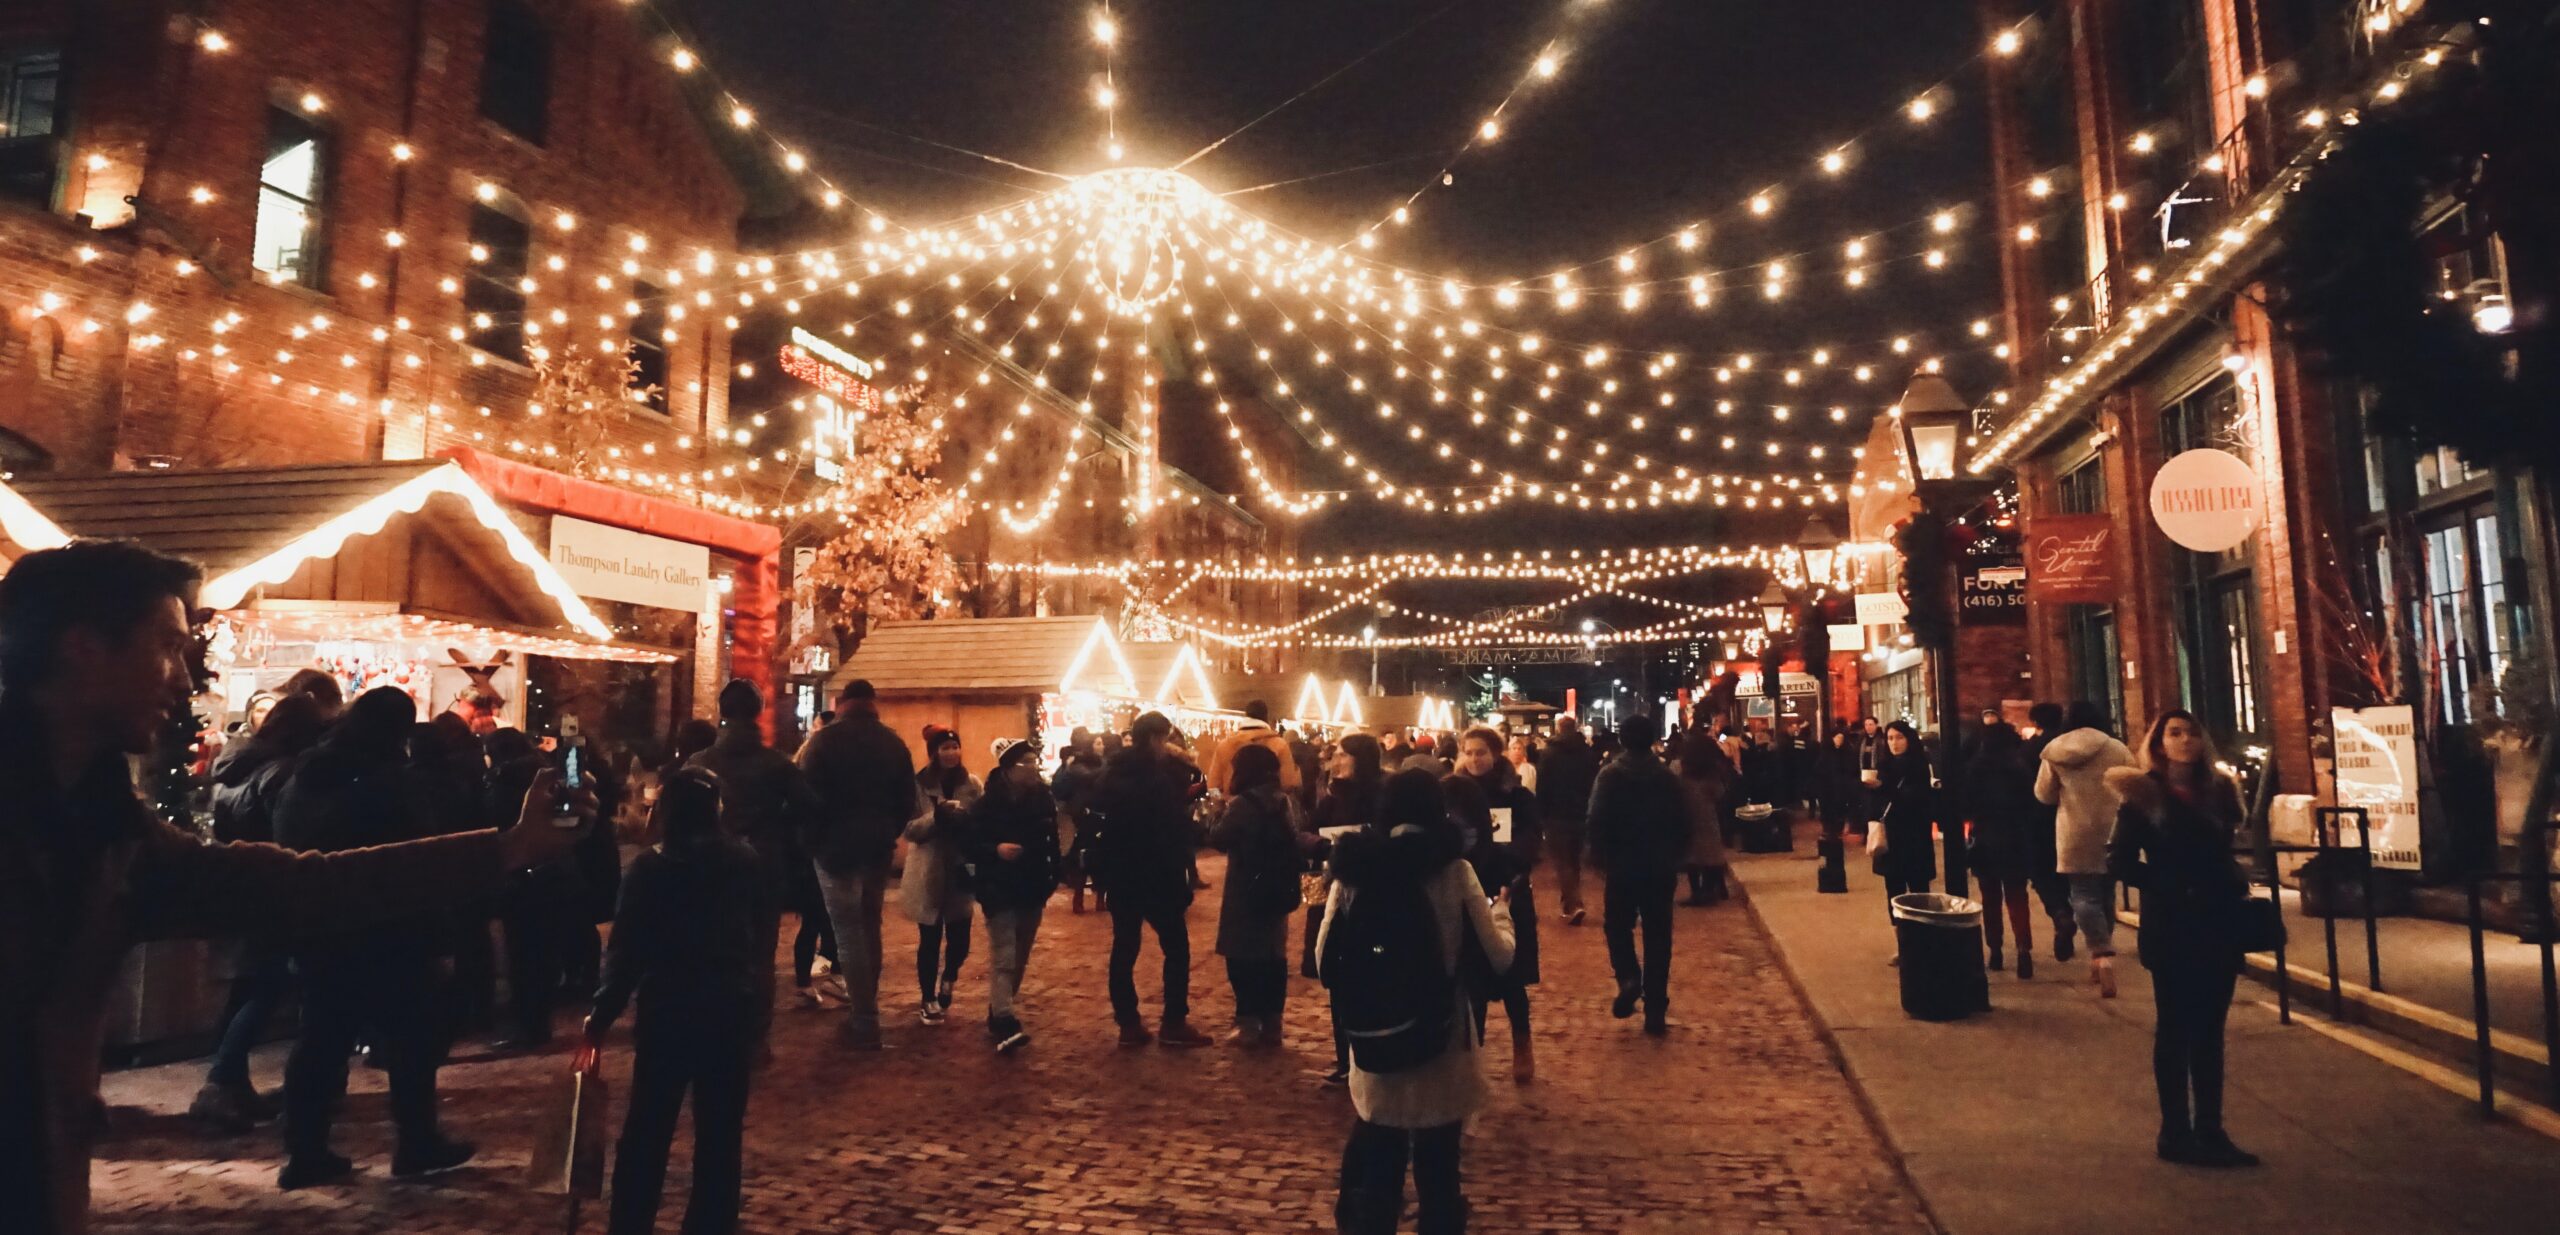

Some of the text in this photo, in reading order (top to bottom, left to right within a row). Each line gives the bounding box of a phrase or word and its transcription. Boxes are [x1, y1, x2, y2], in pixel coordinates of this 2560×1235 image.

[558, 544, 703, 588] Thompson Landry Gallery
[1963, 594, 2003, 608] (416)
